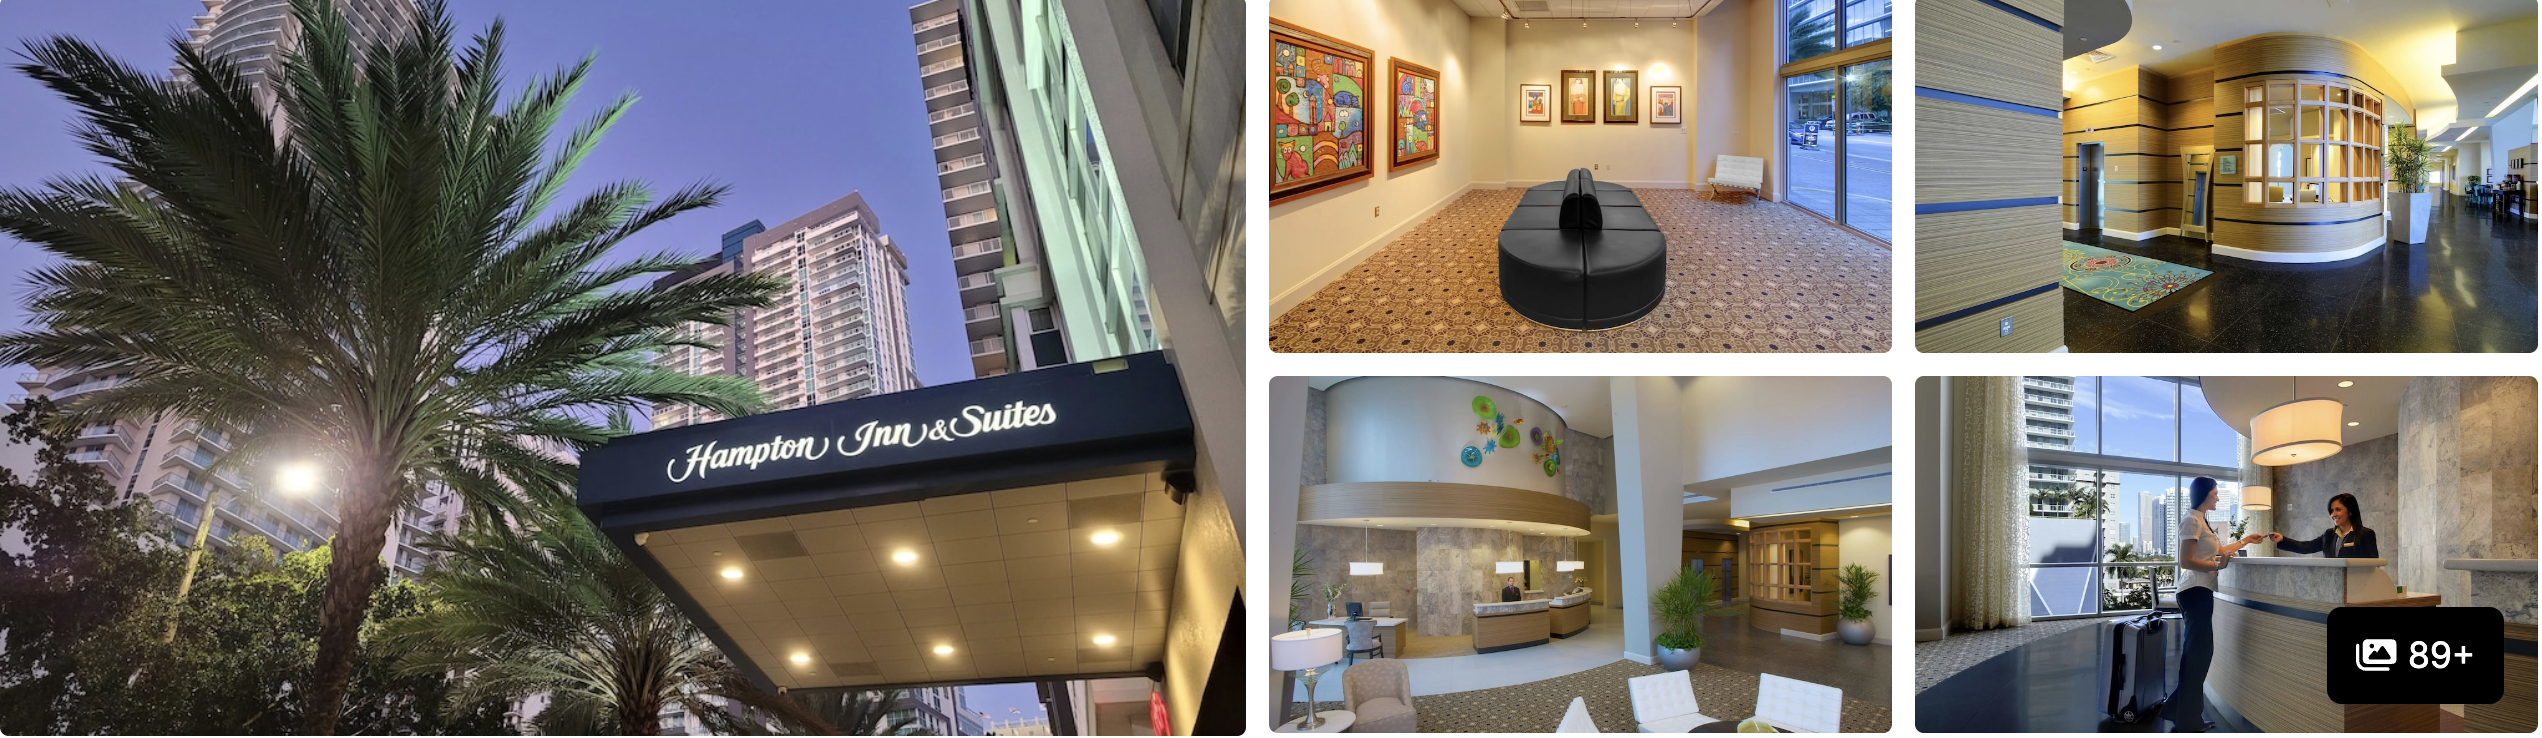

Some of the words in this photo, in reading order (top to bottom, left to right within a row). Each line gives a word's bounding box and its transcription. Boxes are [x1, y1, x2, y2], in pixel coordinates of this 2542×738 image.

[667, 435, 829, 483] Hampton
[837, 420, 928, 457] Inn
[929, 419, 954, 441] &
[950, 400, 1057, 438] Suites
